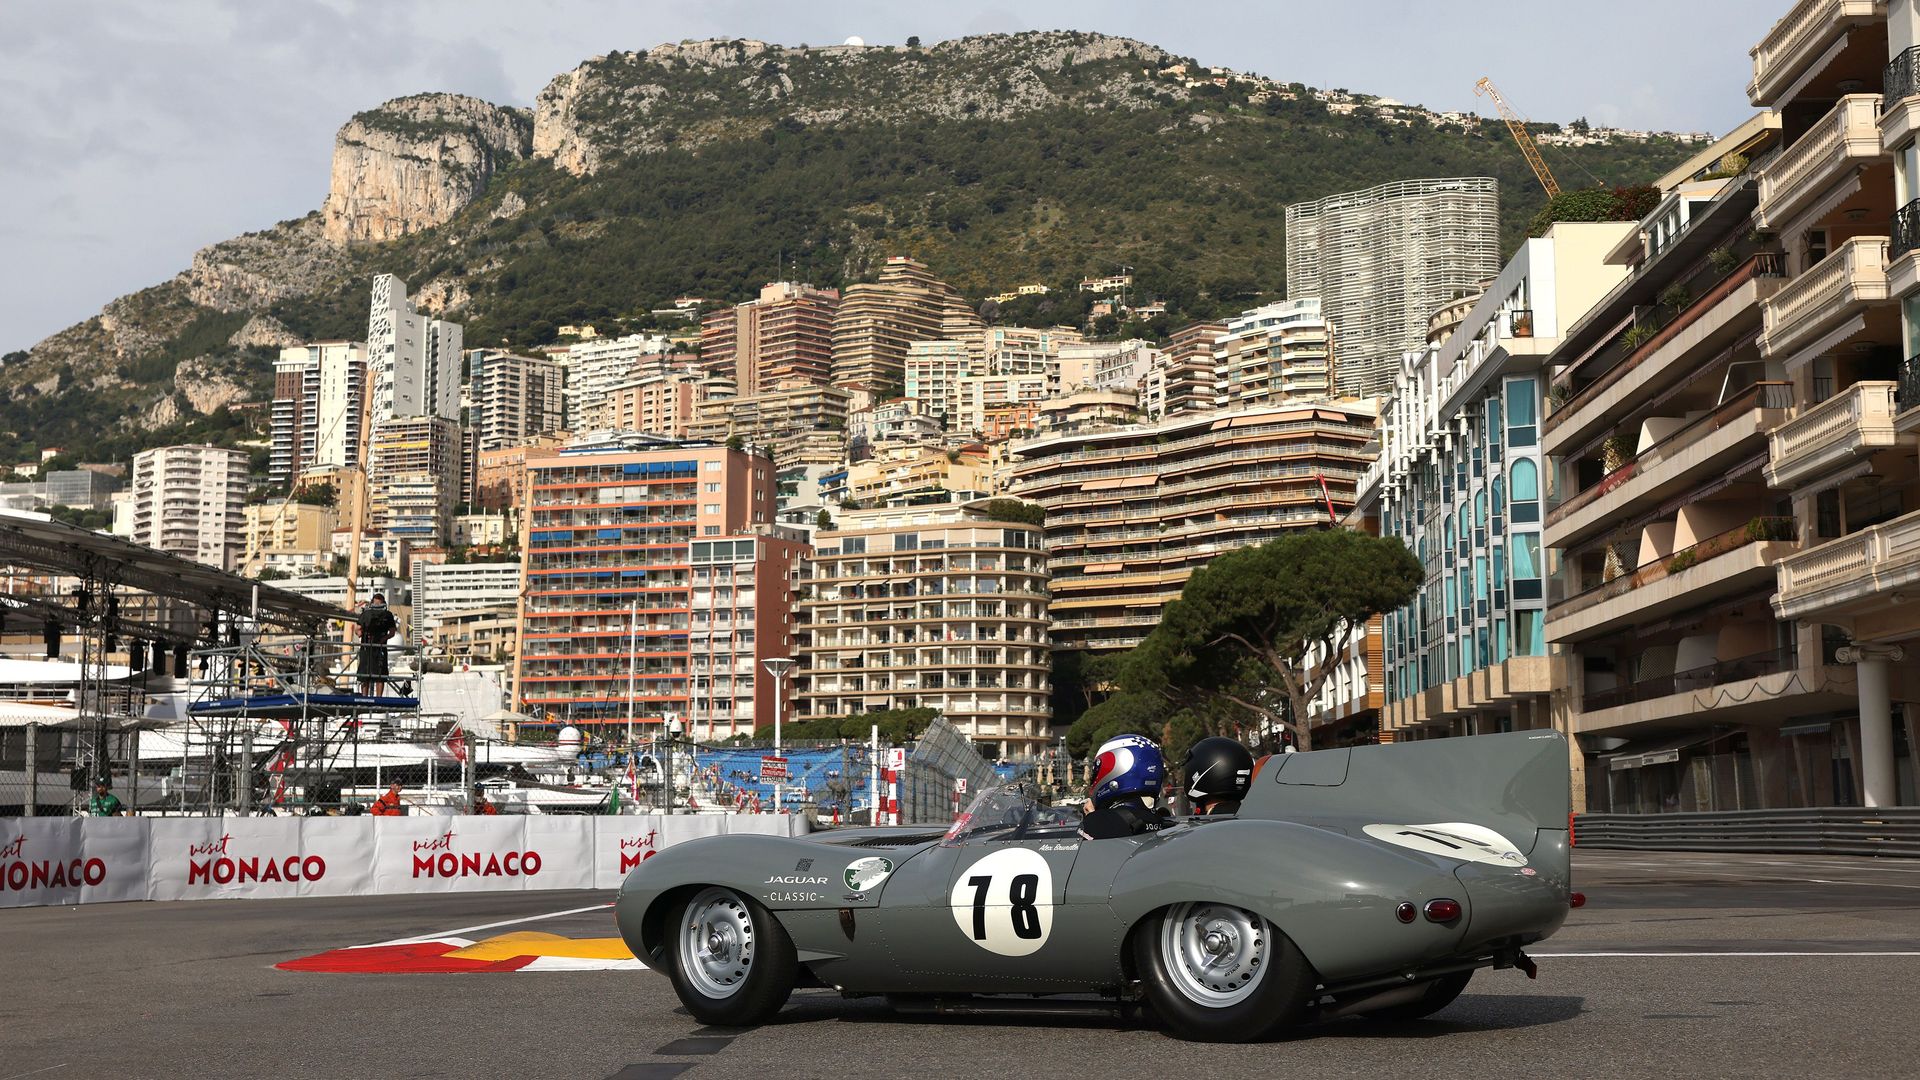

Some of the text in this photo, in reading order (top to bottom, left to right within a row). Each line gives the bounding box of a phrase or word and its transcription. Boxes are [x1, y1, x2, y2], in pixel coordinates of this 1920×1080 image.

[0, 834, 28, 858] sit
[190, 833, 234, 856] visit
[413, 830, 457, 851] visit
[620, 829, 658, 849] visit
[188, 856, 326, 885] MONACO
[413, 851, 542, 878] MONACO
[620, 850, 657, 874] M
[0, 858, 106, 891] ONACO
[764, 875, 829, 885] JAGUAR
[770, 892, 817, 901] CLASSIC
[967, 873, 1043, 941] 78
